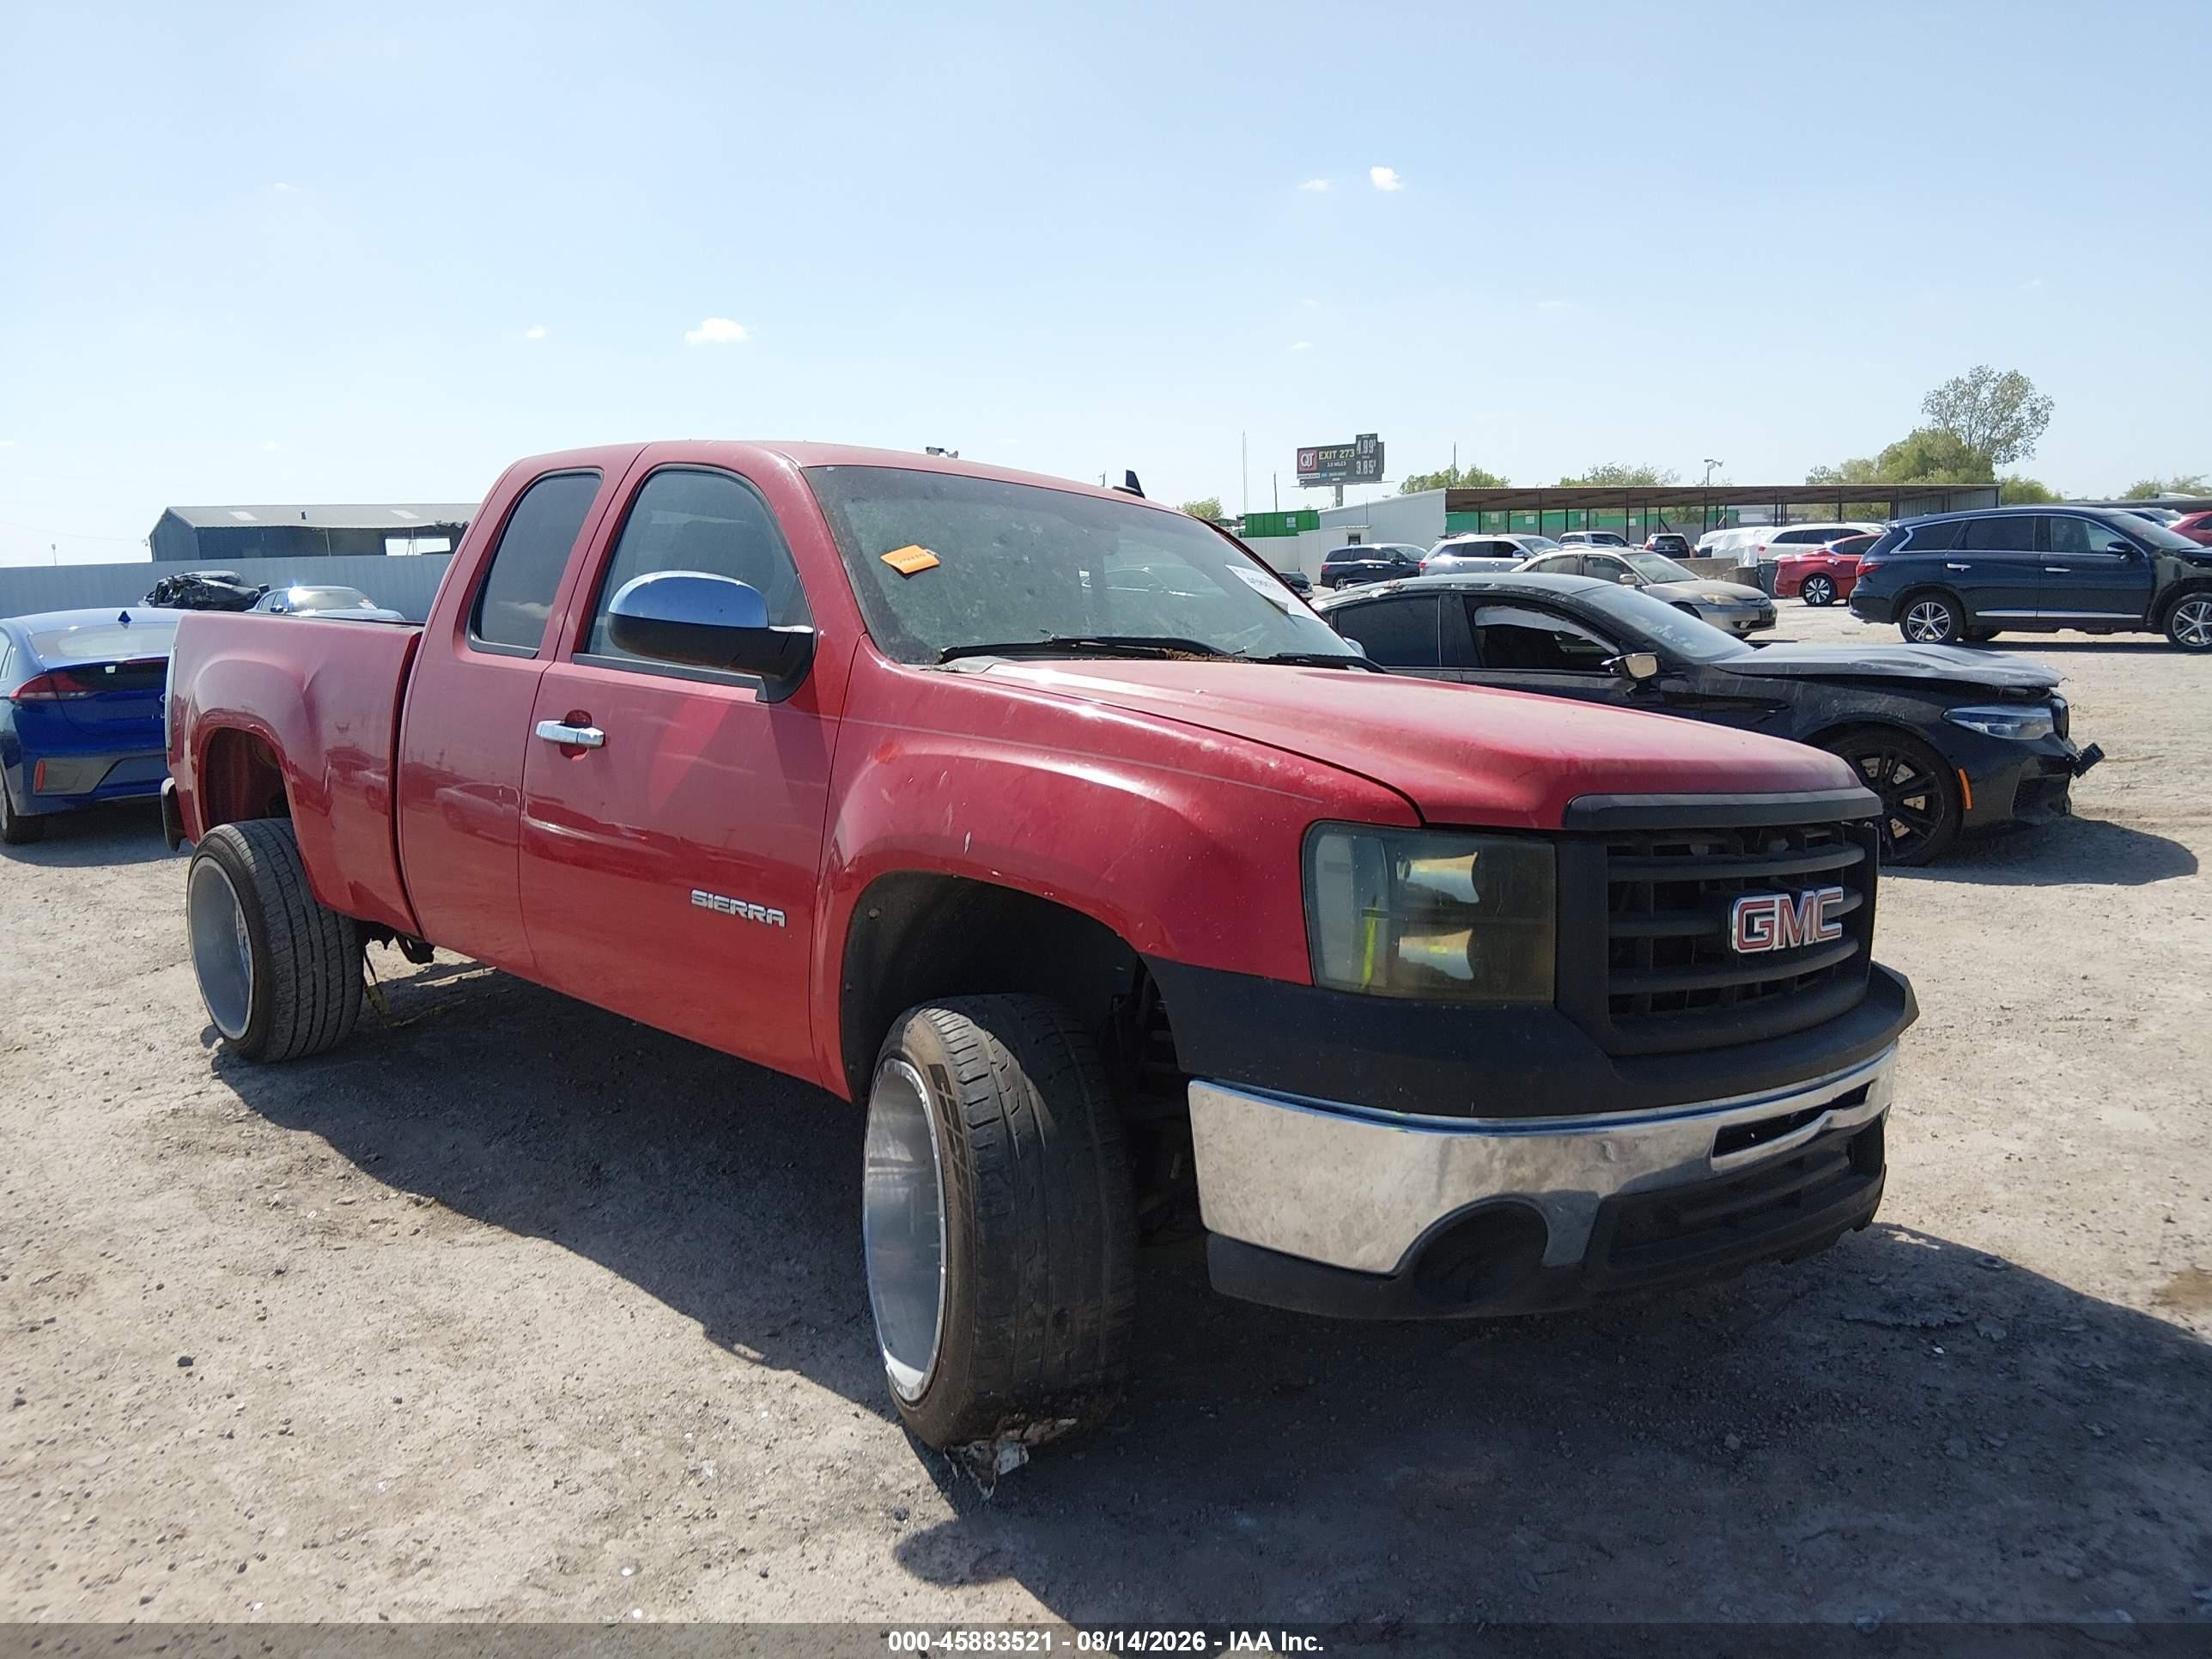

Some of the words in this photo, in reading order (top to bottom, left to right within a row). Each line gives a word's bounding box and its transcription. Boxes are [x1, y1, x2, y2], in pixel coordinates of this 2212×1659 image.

[1300, 453, 1314, 467] QT
[1319, 450, 1337, 460] EXIT
[1339, 448, 1355, 459] 273
[691, 889, 786, 927] SIERRA
[1732, 886, 1843, 953] GMC
